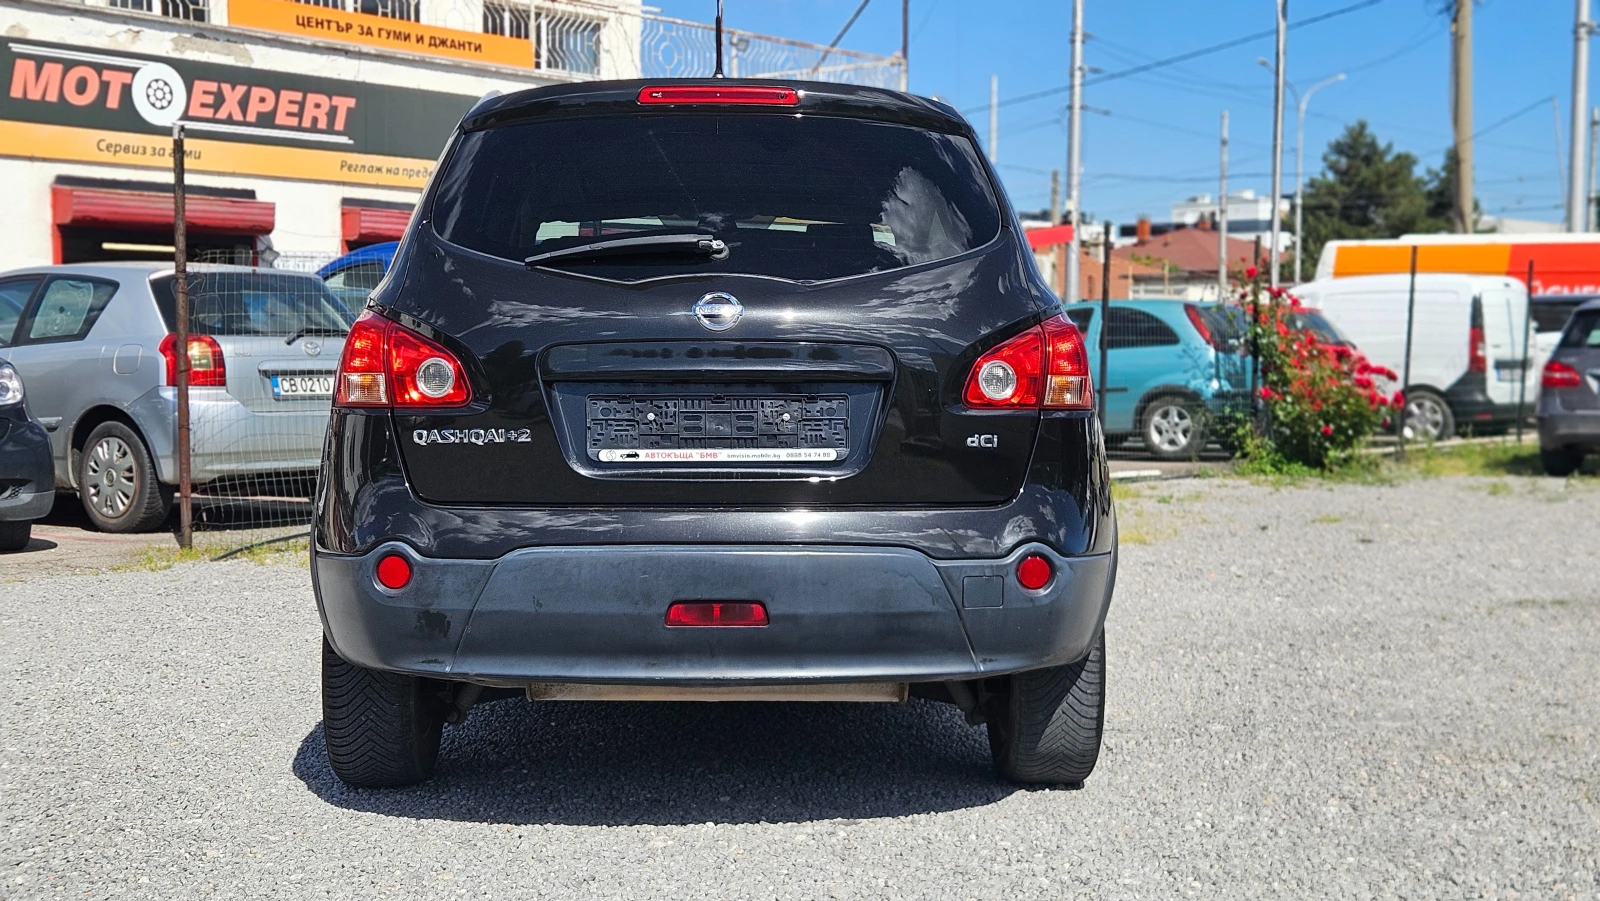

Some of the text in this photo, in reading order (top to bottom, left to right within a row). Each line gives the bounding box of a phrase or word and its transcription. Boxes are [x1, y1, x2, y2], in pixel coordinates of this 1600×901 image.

[295, 14, 482, 53] ЦЕНТЪР ЗА ГУМИ И ДЖАНТИ
[187, 79, 357, 132] EXPERT
[96, 138, 202, 162] Сервиз за гми
[340, 160, 384, 175] Реглаж
[385, 167, 400, 176] на
[300, 377, 331, 393] 0210
[966, 433, 998, 448] dCi
[645, 452, 693, 460] АВТОКЪЩА
